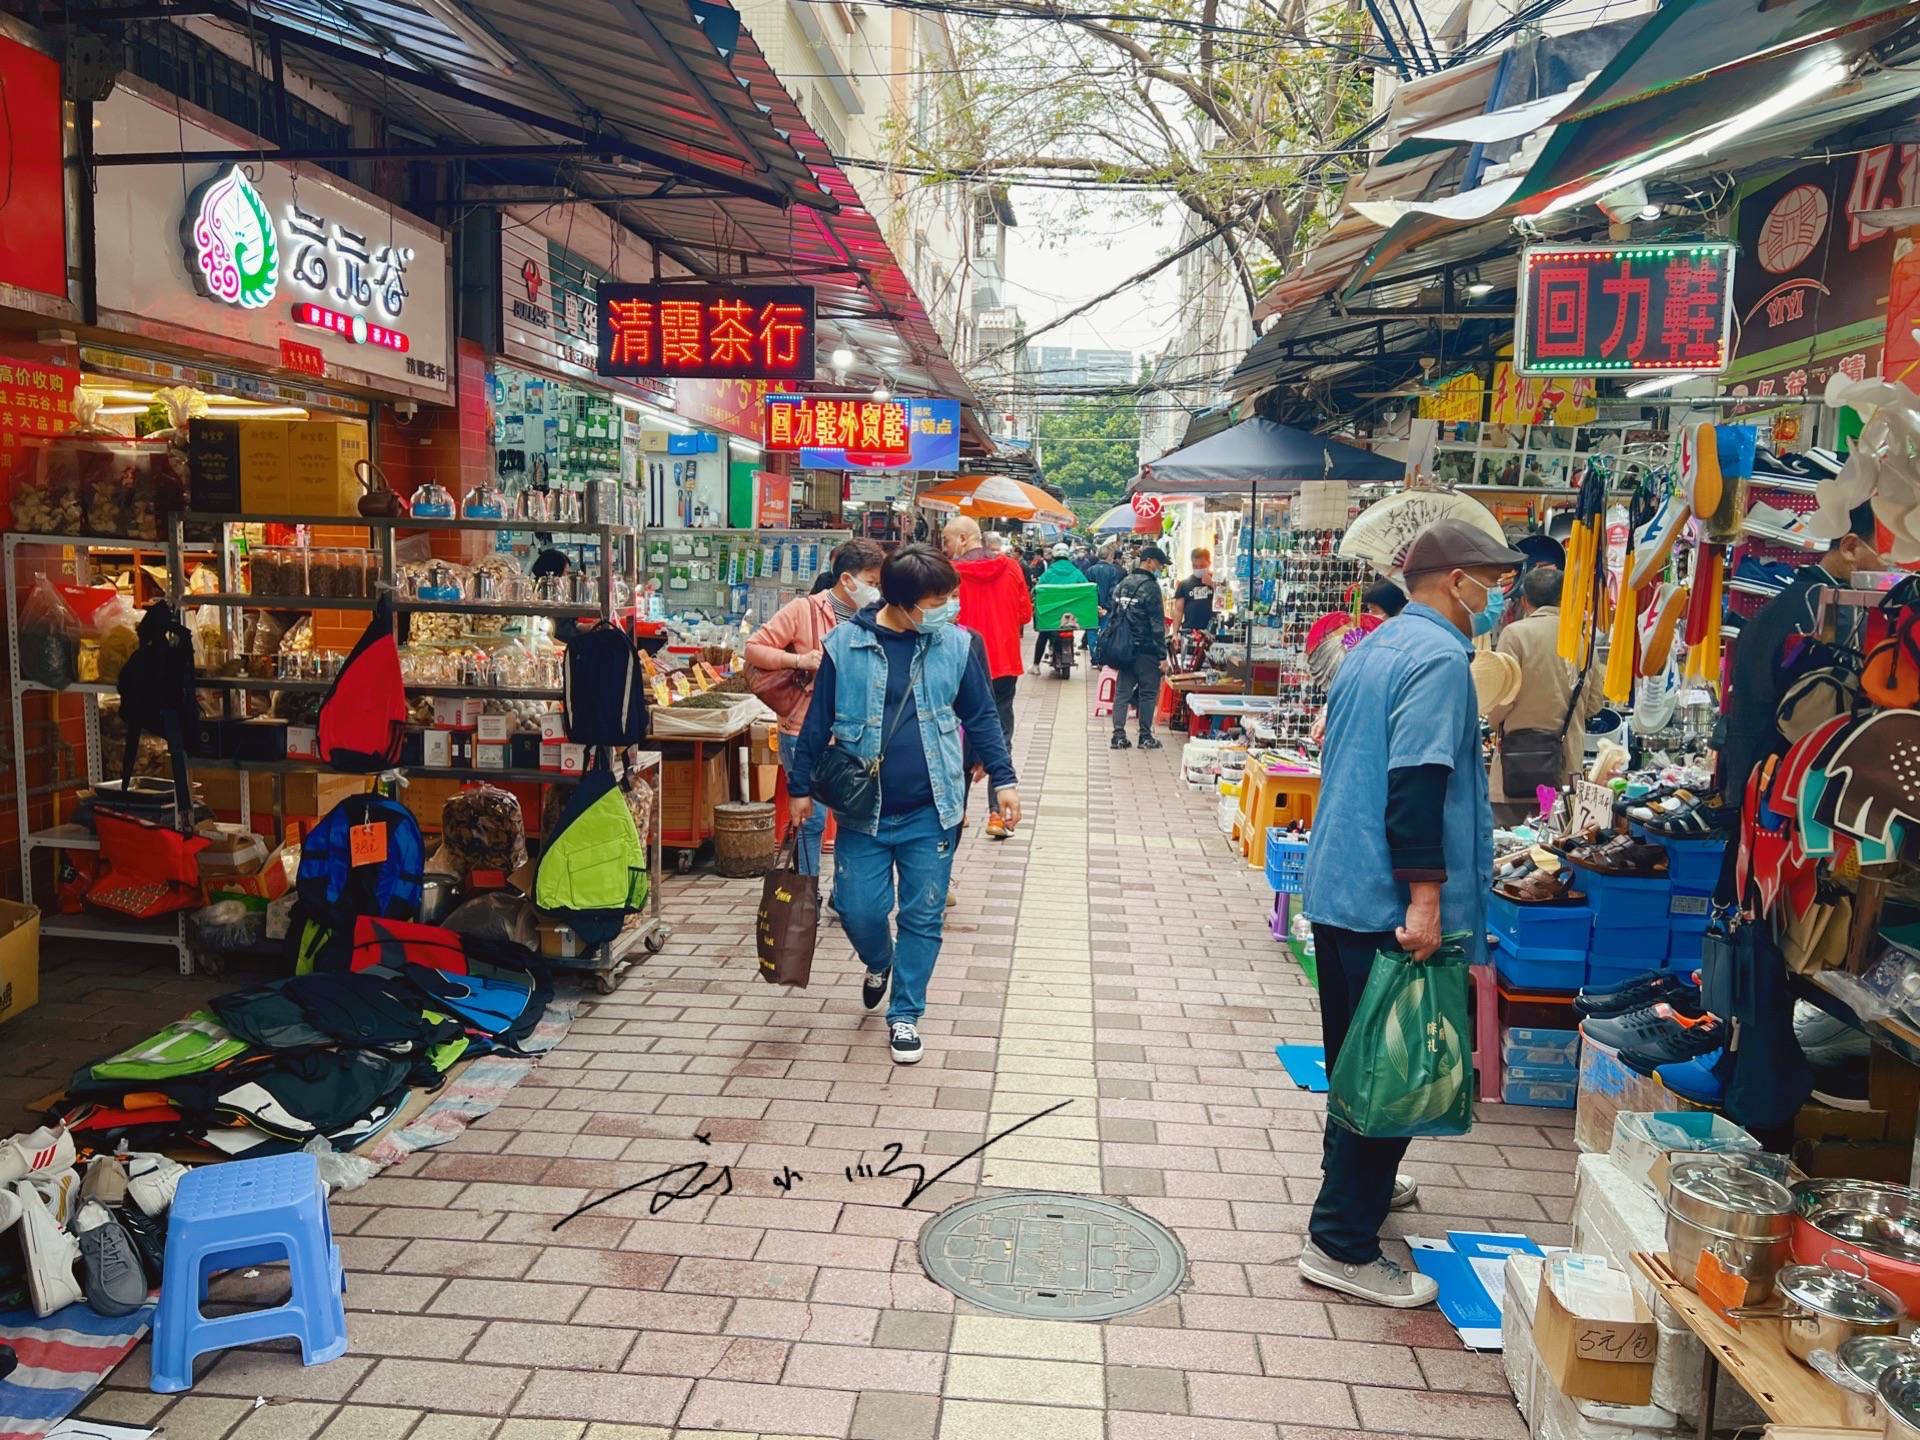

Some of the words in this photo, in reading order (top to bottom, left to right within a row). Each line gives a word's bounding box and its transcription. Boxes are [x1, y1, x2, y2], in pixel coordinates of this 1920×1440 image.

[609, 298, 803, 365] 清霞茶行
[1535, 257, 1718, 361] 回力鞋
[0, 366, 64, 393] 高价收购
